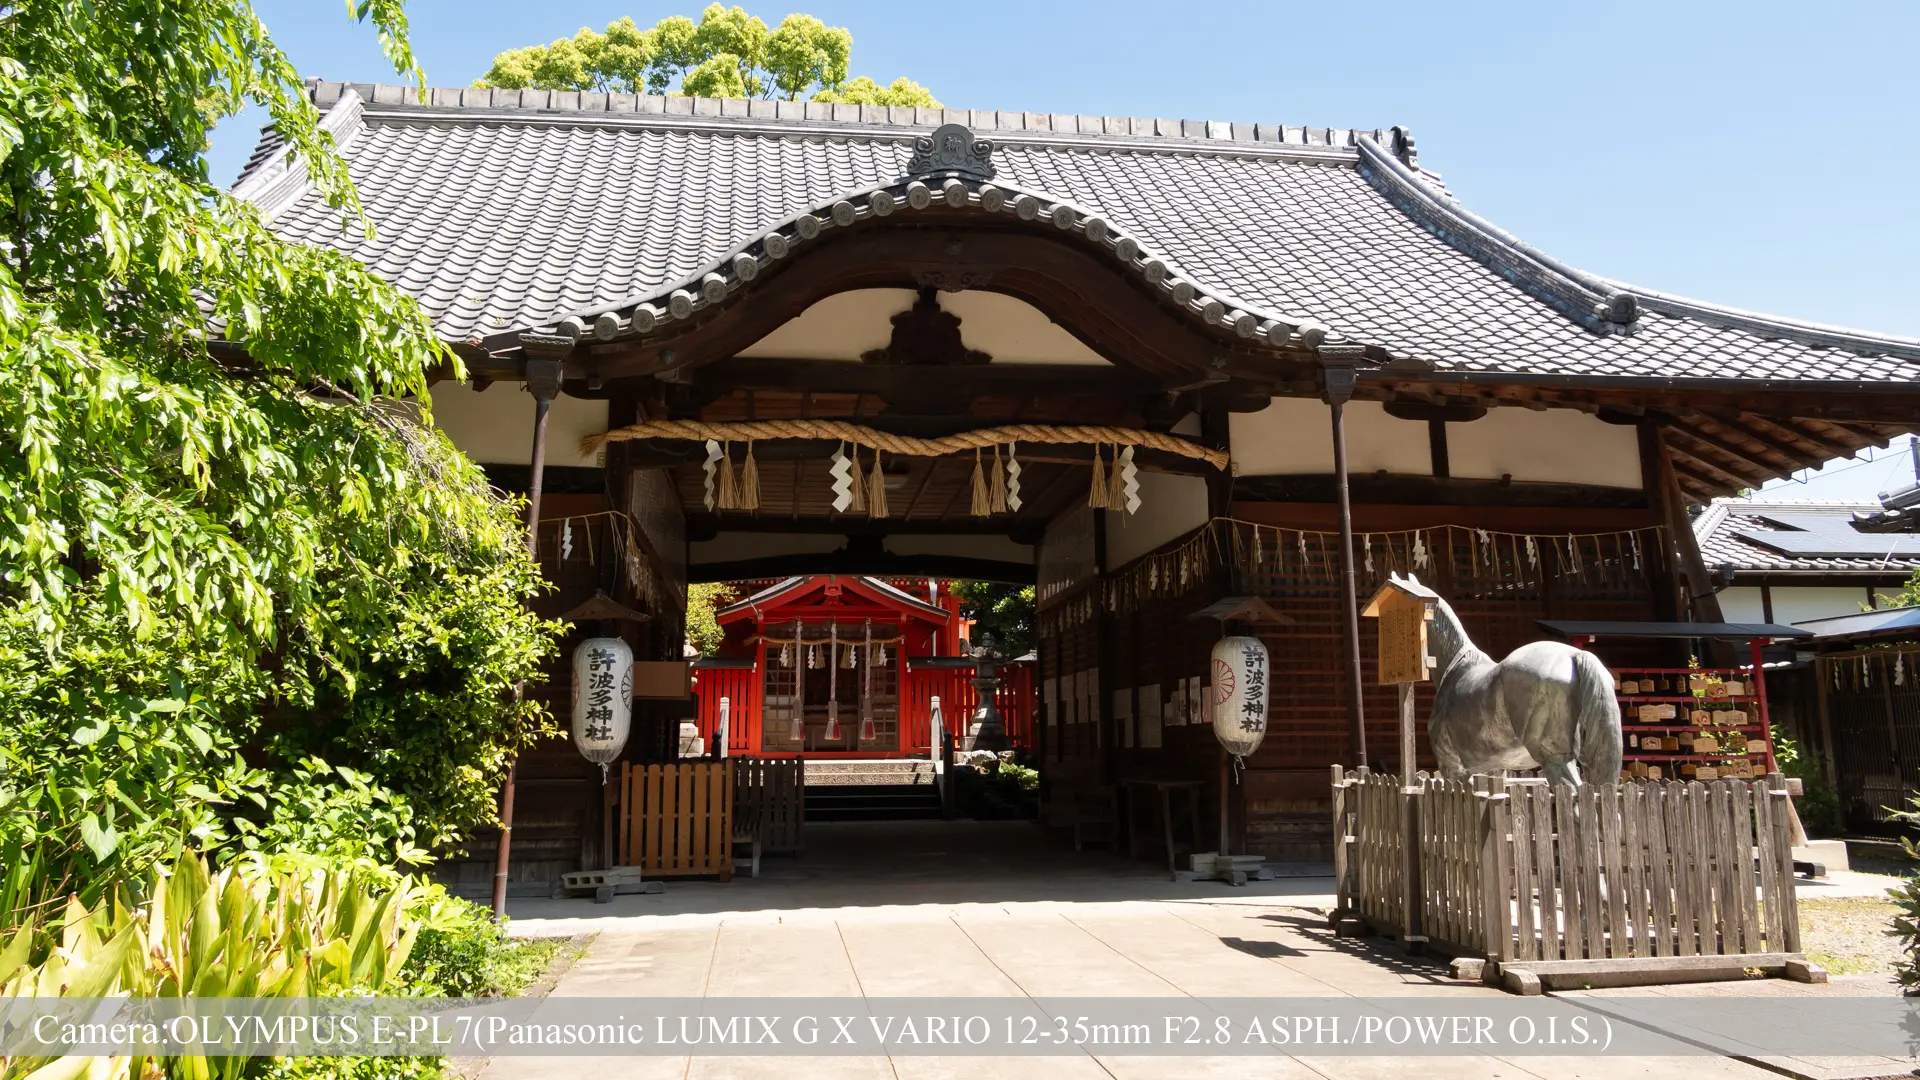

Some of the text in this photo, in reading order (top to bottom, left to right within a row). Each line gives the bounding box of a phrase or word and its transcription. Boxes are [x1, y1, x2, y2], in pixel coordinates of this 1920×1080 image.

[584, 647, 617, 742] 許波多神社
[1239, 645, 1265, 734] 許波多神社
